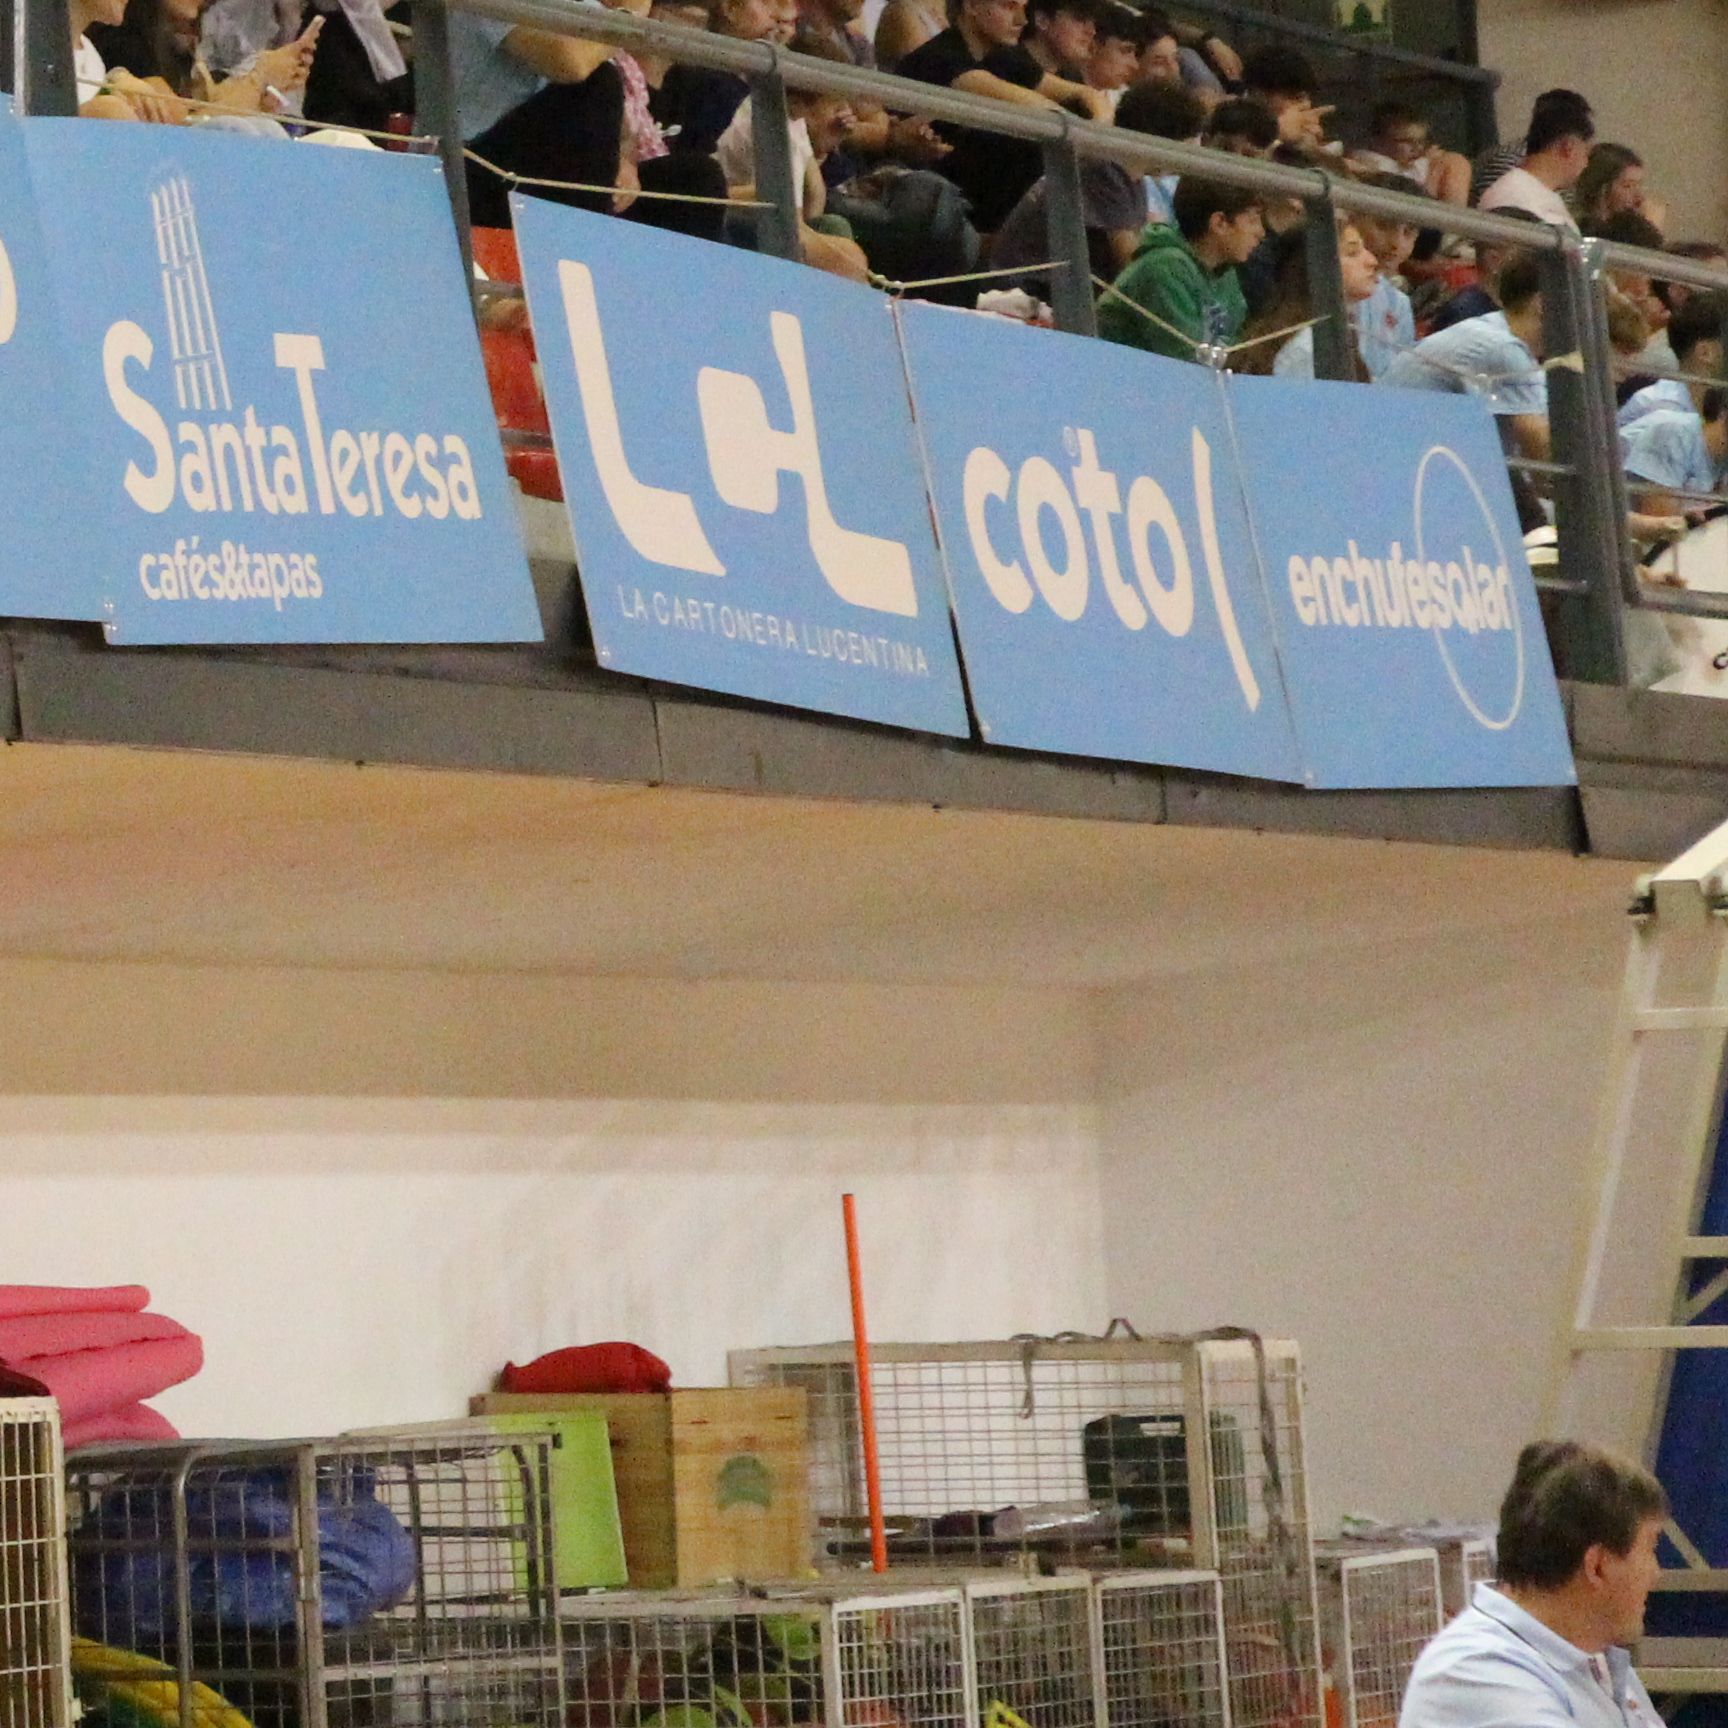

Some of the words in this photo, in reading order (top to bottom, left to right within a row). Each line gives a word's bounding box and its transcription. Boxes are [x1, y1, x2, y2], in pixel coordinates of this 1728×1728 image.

[617, 584, 648, 620] LA
[652, 591, 797, 648] CARTONERA
[801, 624, 930, 676] LUCENTINA
